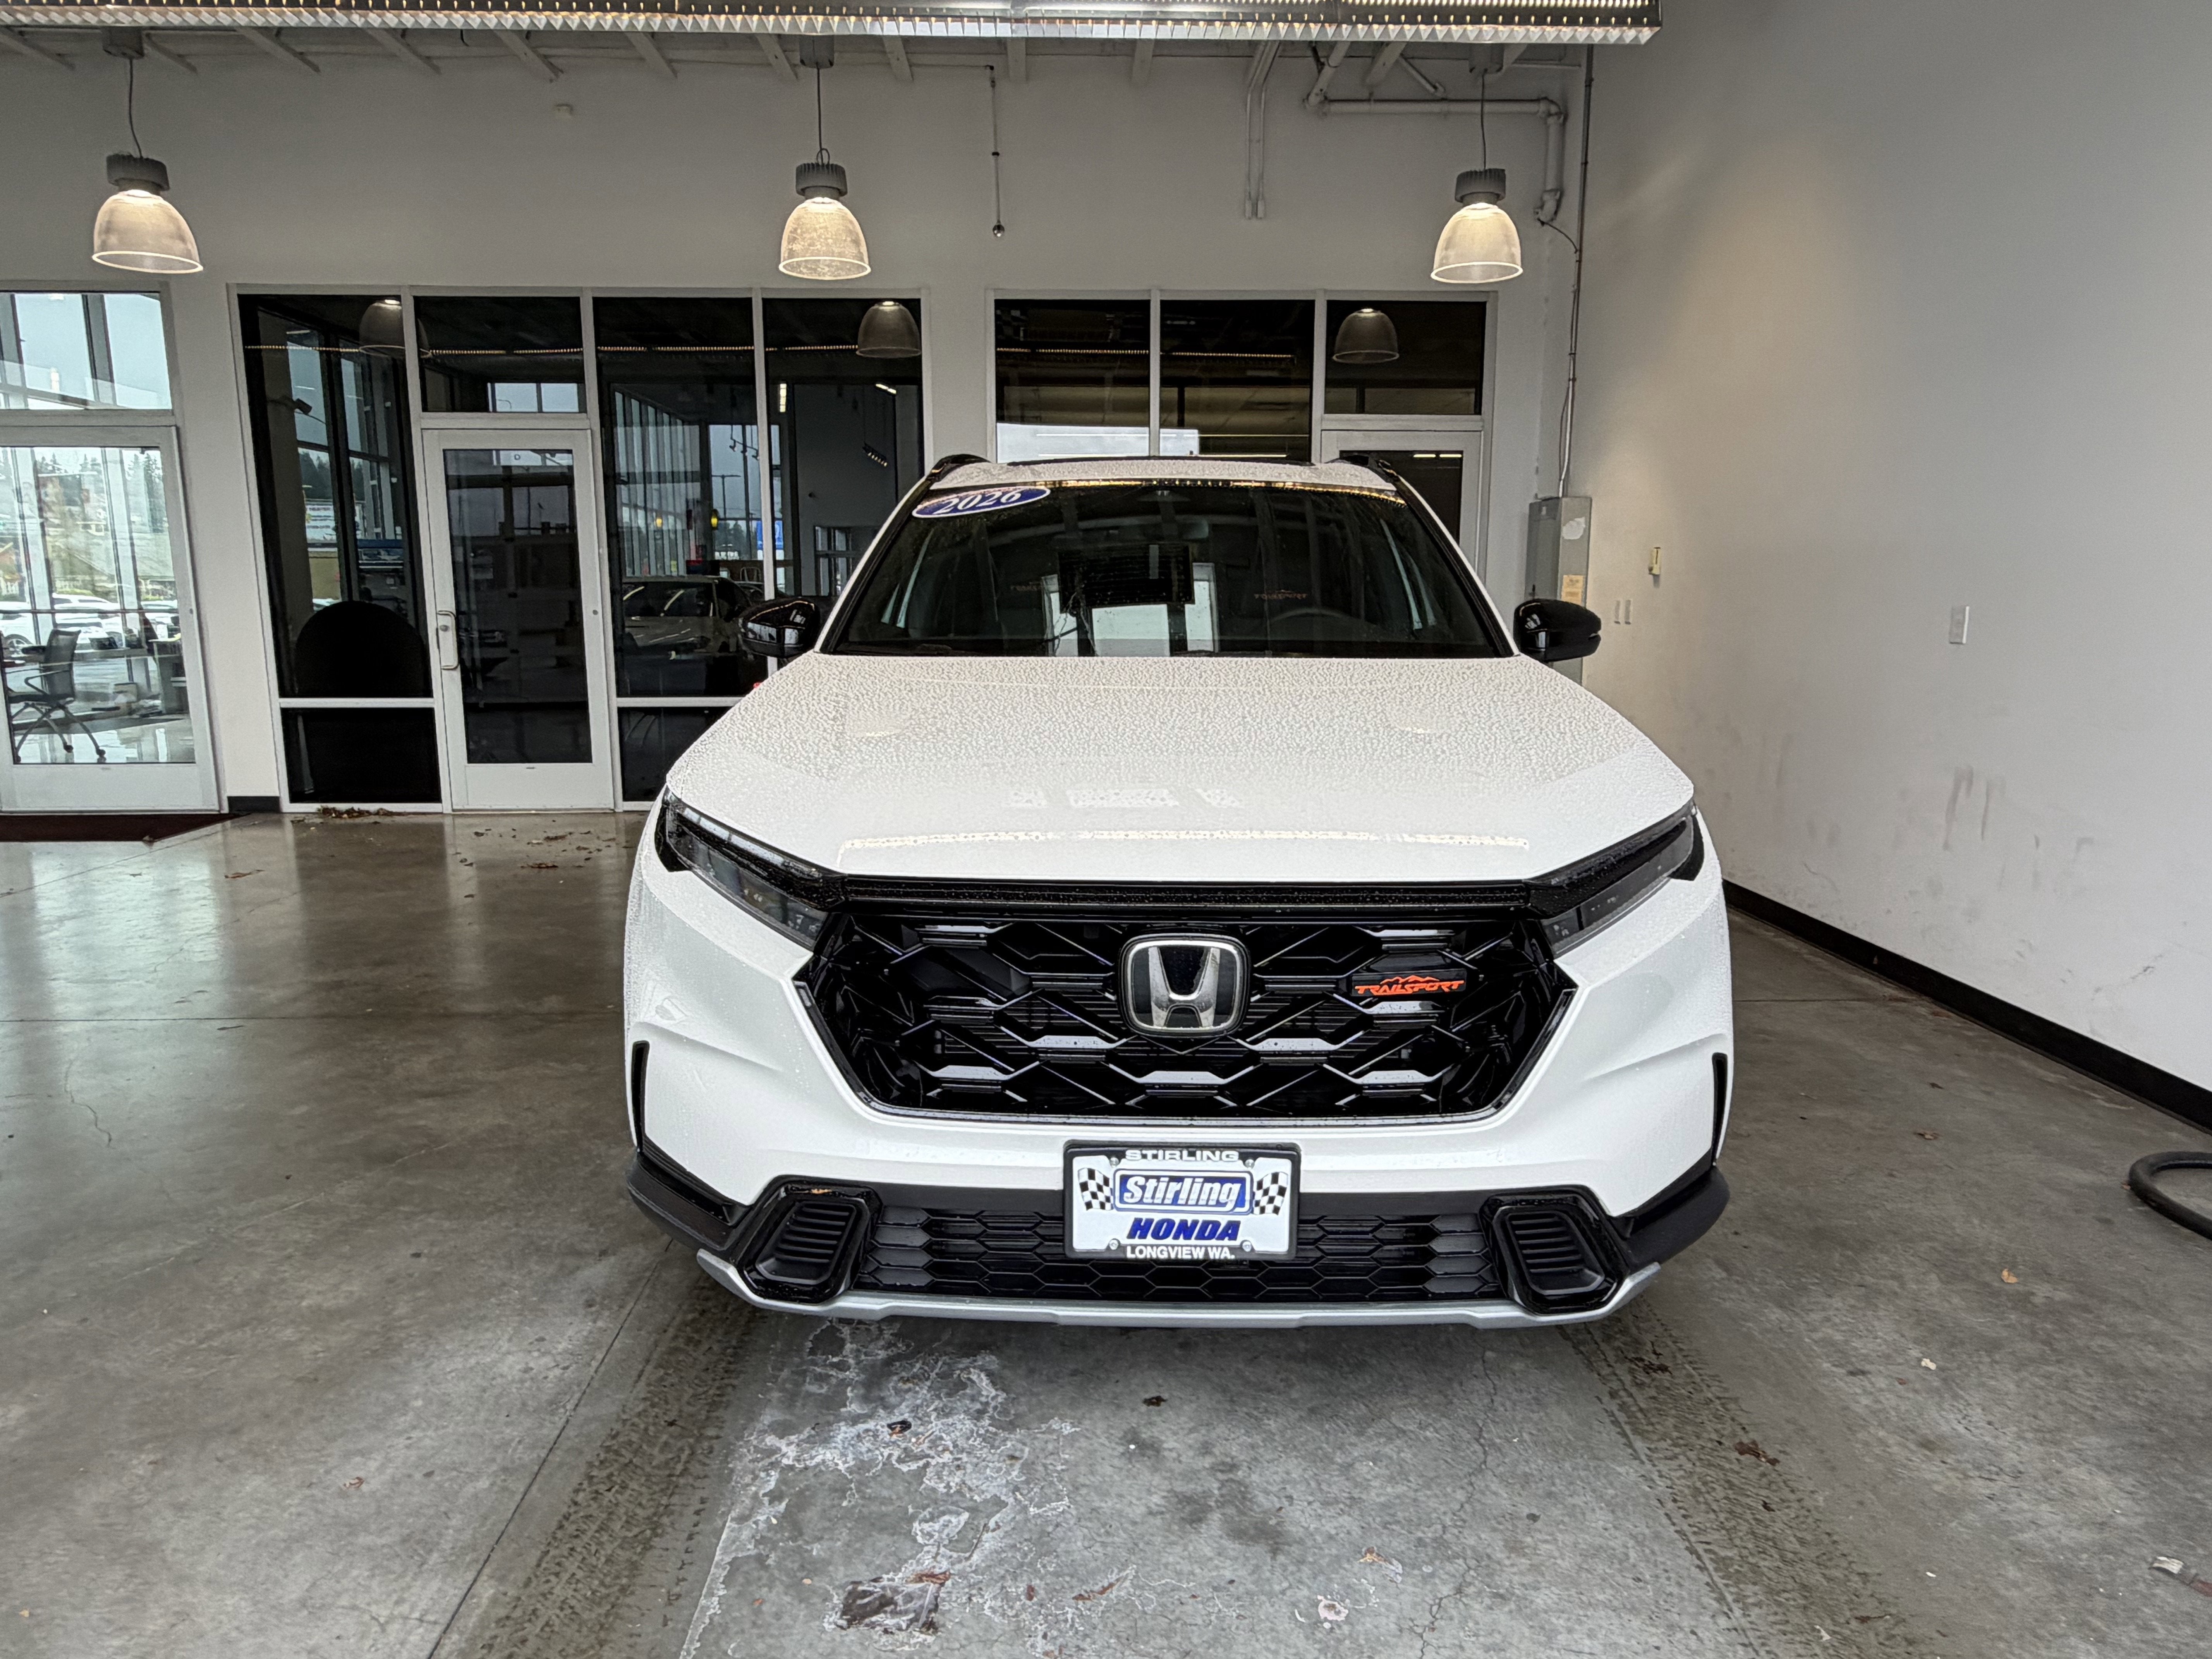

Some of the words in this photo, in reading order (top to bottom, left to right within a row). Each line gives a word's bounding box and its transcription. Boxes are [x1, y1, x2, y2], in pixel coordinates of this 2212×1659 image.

[932, 491, 1022, 515] 2026
[1355, 980, 1465, 995] TRAILSPORT
[1125, 1149, 1239, 1161] STIRLING
[1123, 1176, 1242, 1209] Stirling
[1127, 1218, 1241, 1241] HONDA
[1127, 1245, 1205, 1259] LONGVIEW
[1207, 1247, 1235, 1259] WA.
